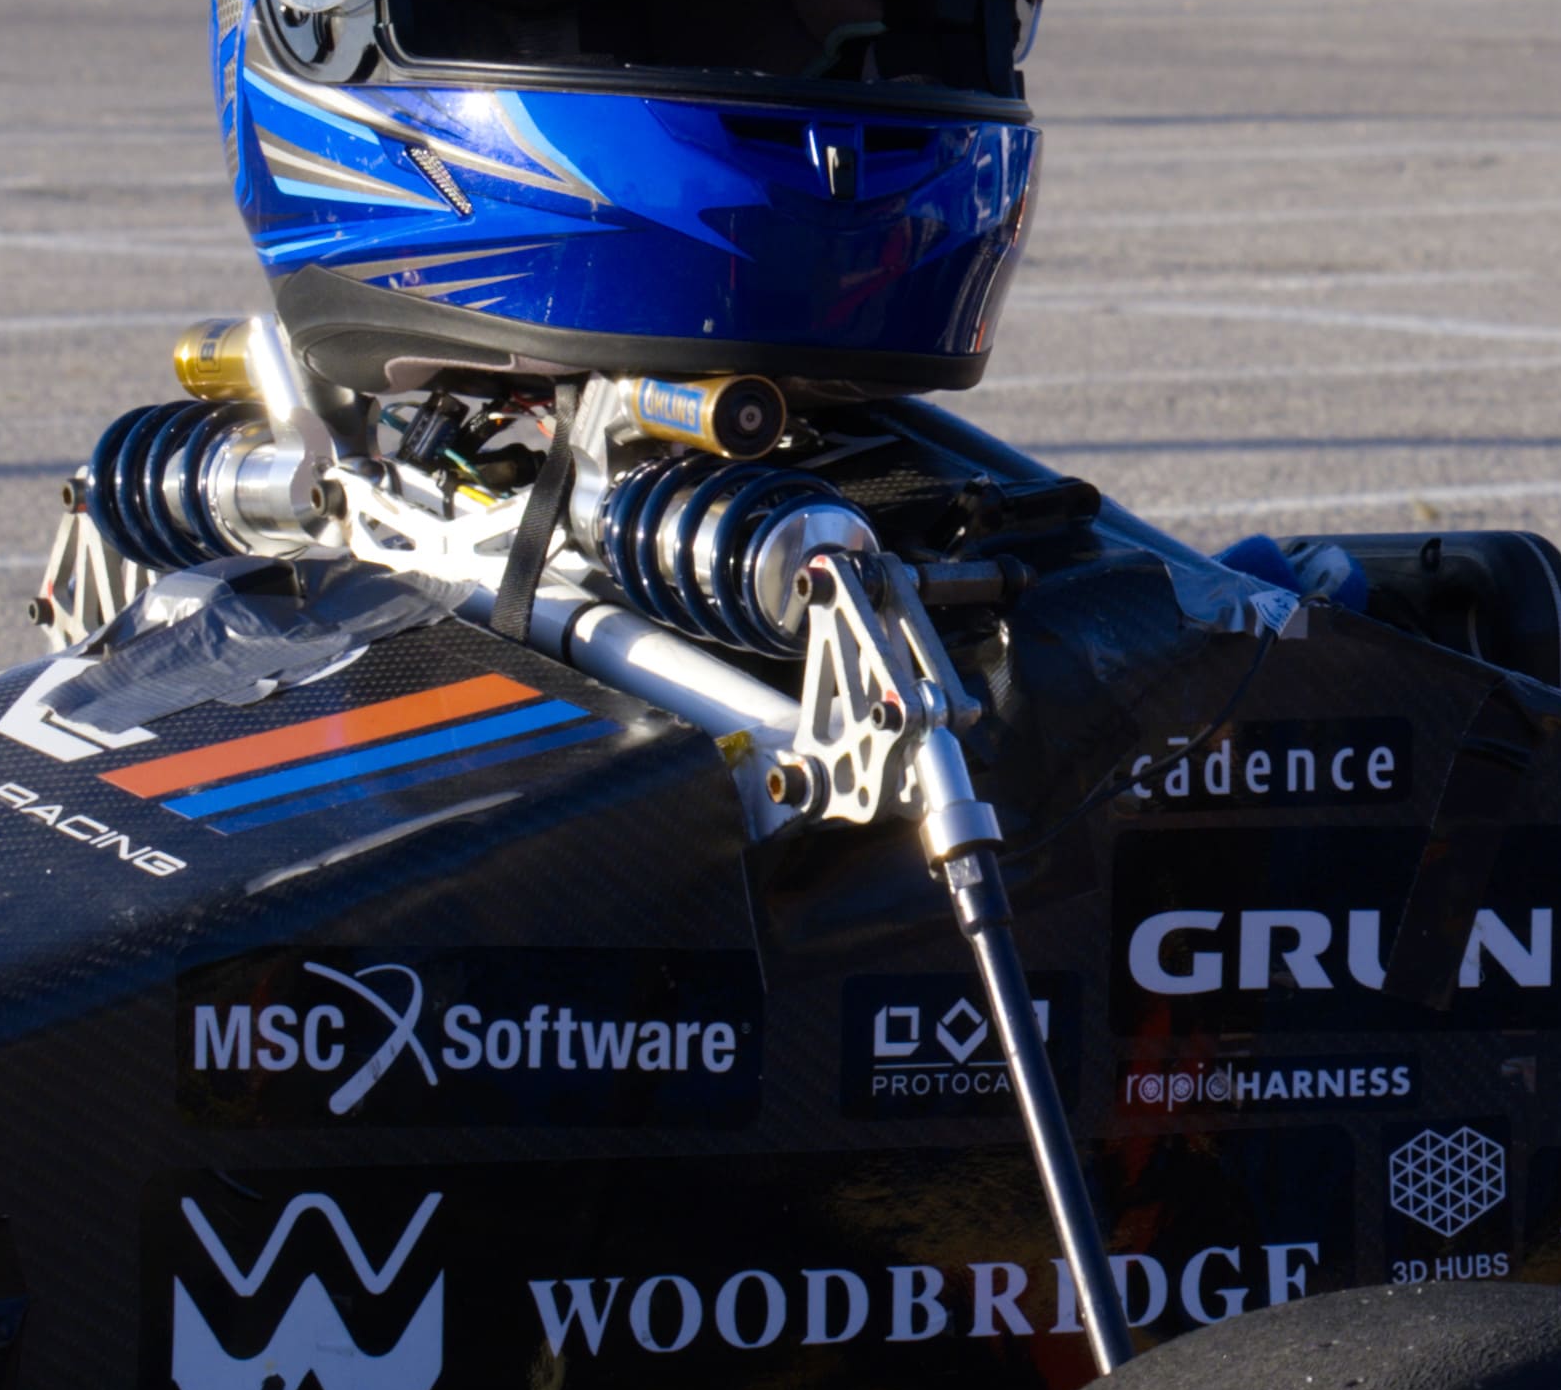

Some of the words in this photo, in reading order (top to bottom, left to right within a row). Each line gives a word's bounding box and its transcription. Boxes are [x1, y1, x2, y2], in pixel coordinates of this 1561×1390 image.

[193, 1004, 345, 1072] MSC
[441, 1003, 737, 1073] Software
[871, 1072, 1013, 1098] PROTOCA
[1392, 1259, 1427, 1284] 3D
[1435, 1252, 1509, 1278] HUBS
